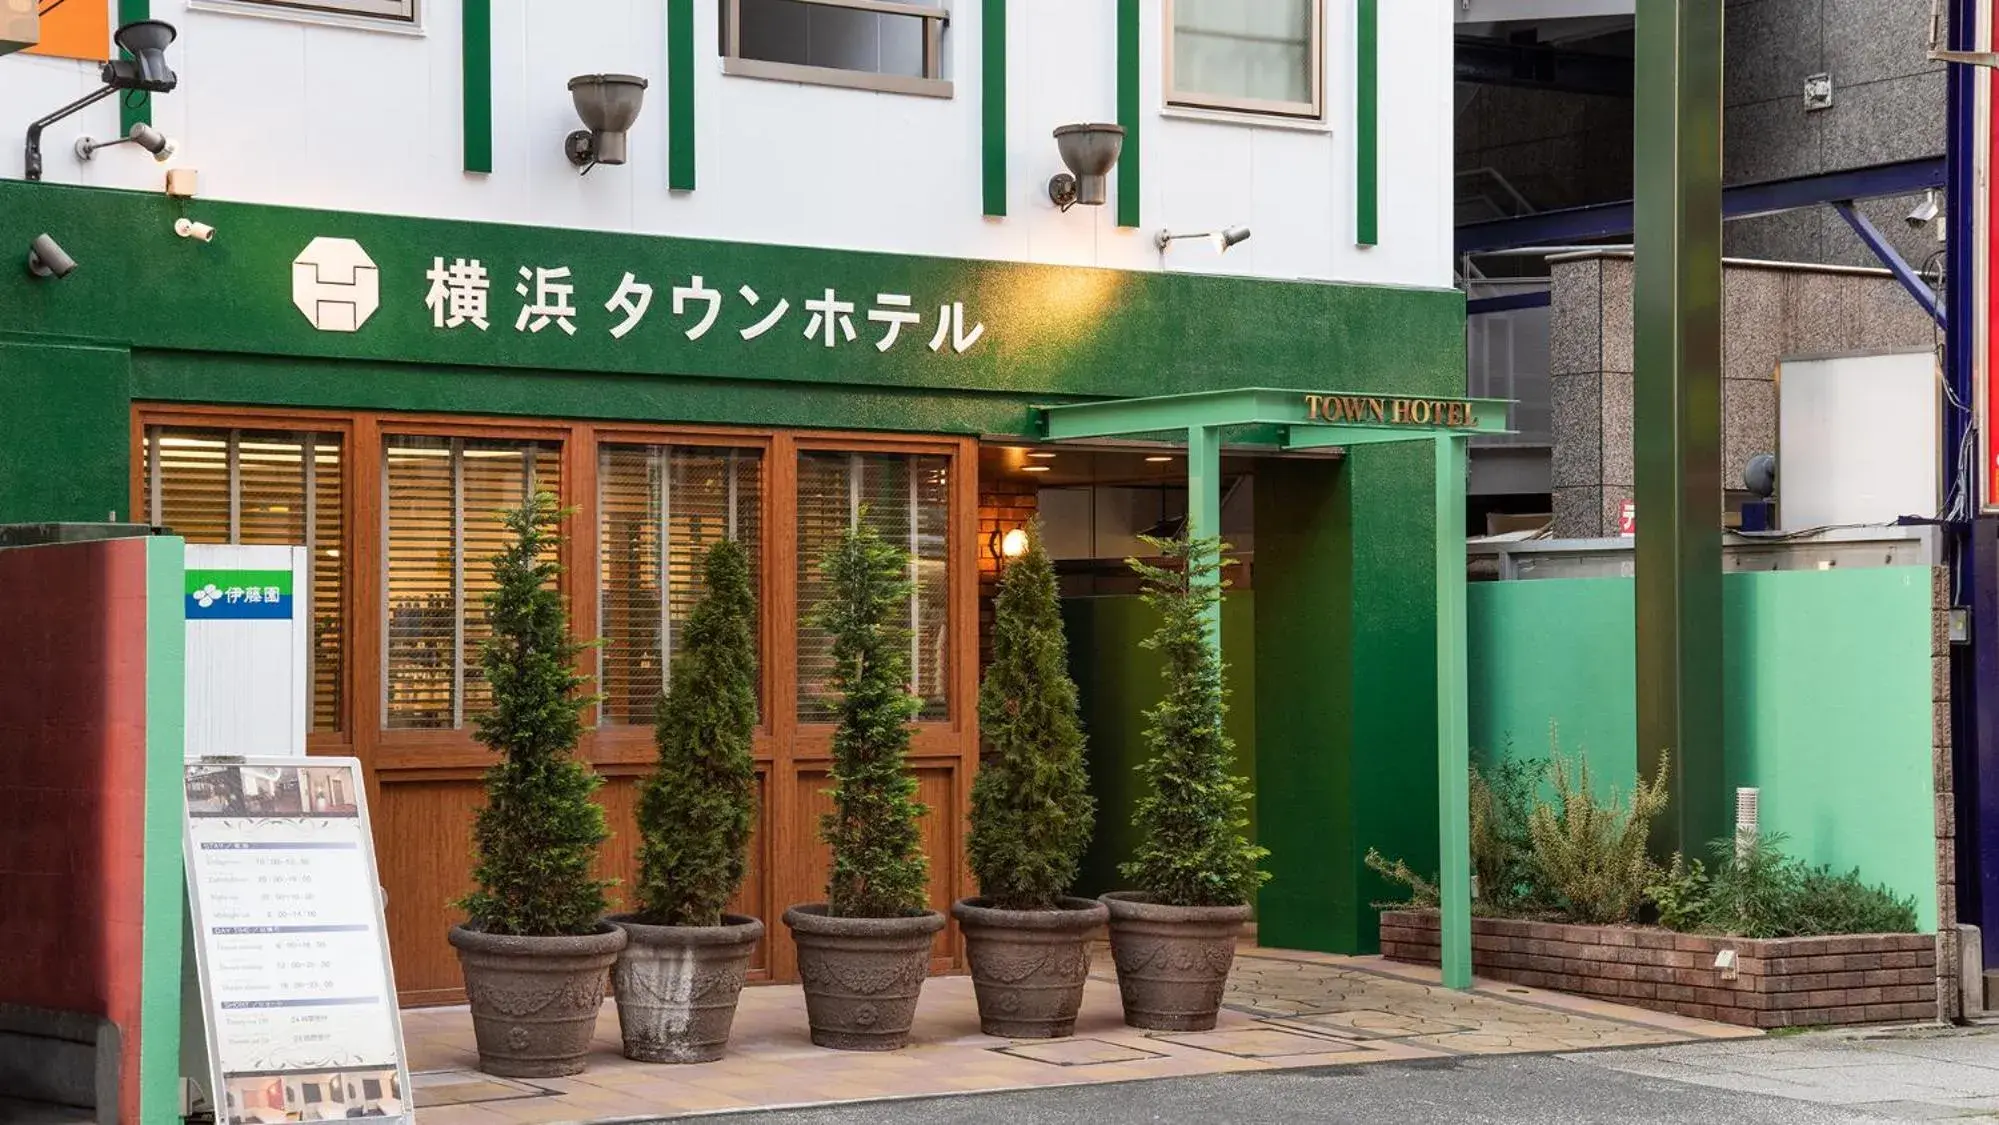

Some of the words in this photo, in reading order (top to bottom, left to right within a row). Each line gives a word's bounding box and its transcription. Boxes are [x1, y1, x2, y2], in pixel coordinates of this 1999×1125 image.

[424, 255, 986, 354] 横浜タウンホテル
[1306, 394, 1384, 423] TOWN
[1391, 399, 1478, 427] HOTEL
[225, 586, 281, 604] 伊藤園
